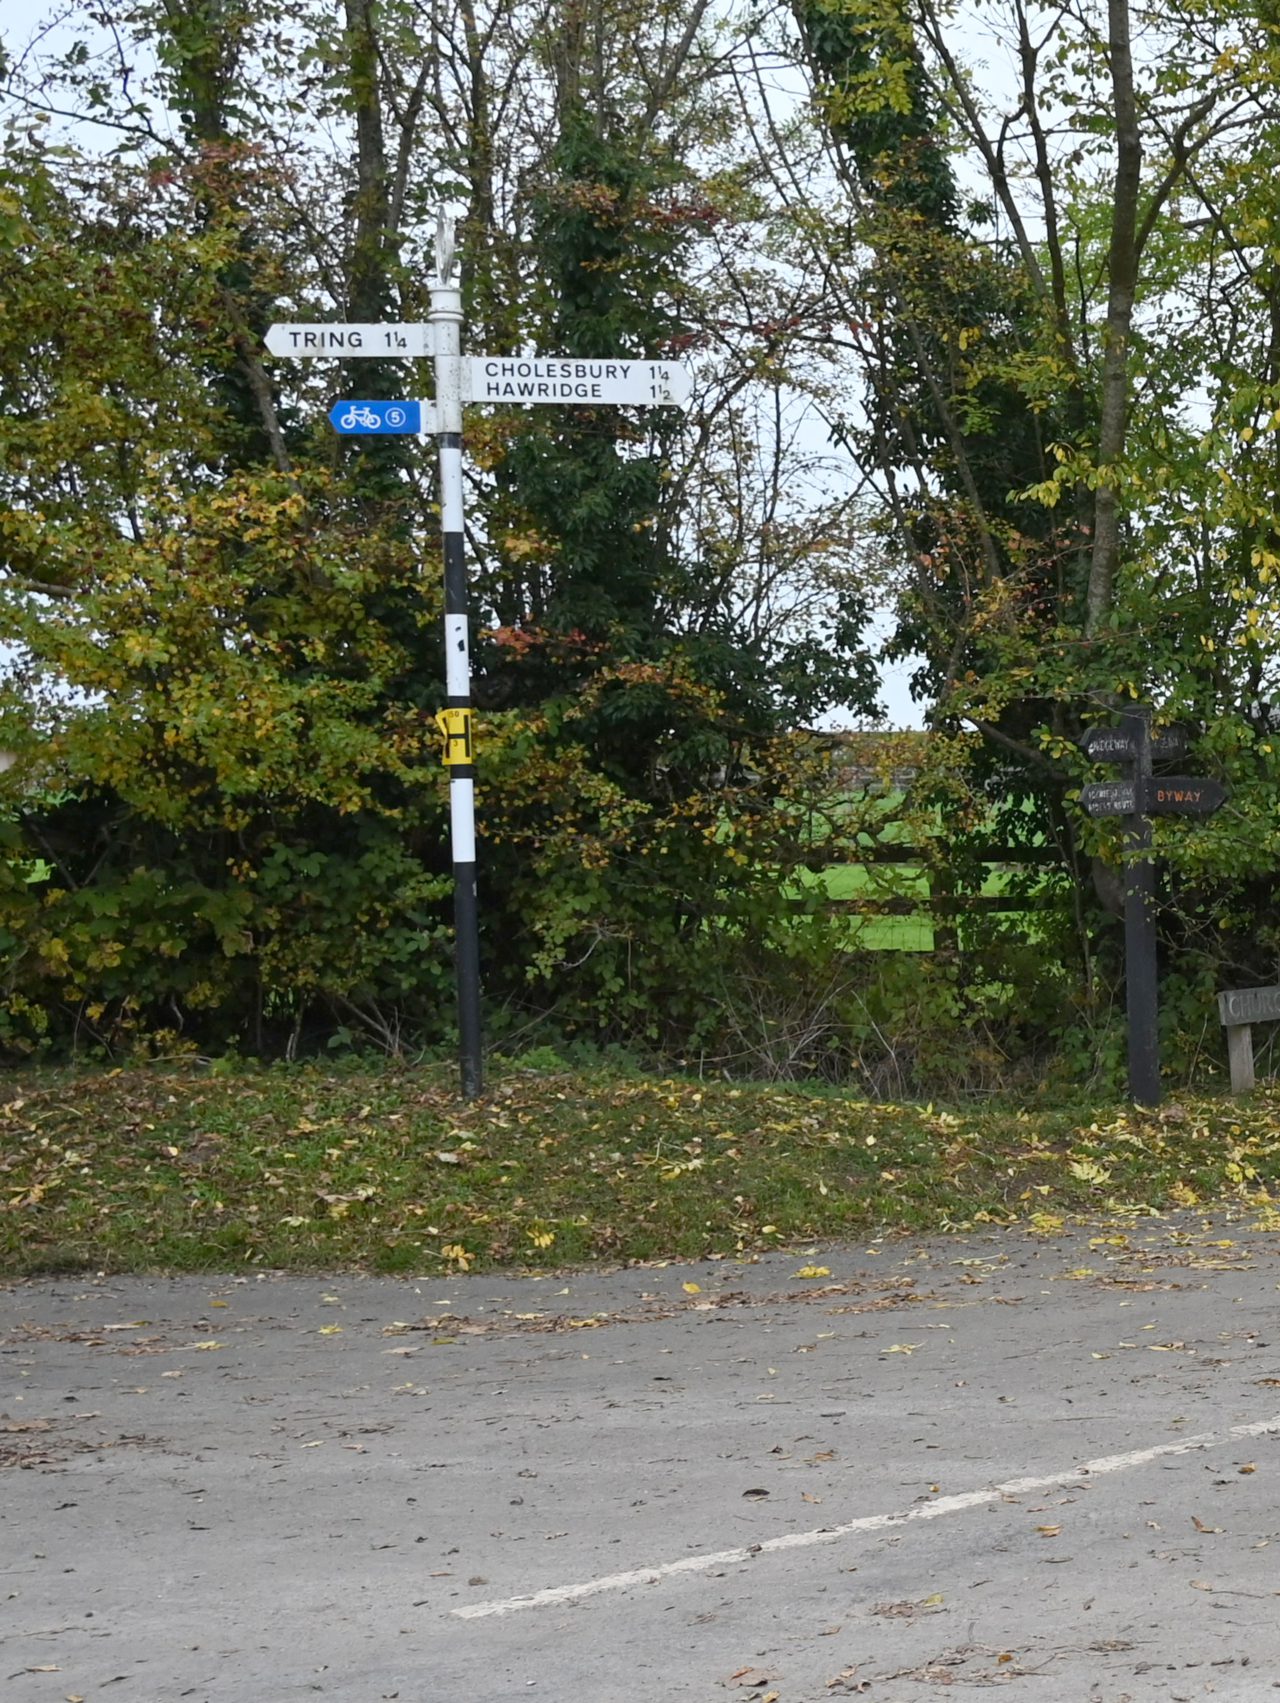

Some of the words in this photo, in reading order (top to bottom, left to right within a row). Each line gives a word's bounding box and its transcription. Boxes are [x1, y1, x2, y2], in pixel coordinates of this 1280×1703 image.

[289, 331, 362, 348] TRING
[485, 362, 631, 379] CHOLESBURY
[486, 382, 603, 399] HAWRIDGE
[390, 411, 401, 424] 5
[1157, 790, 1201, 802] BYWAY
